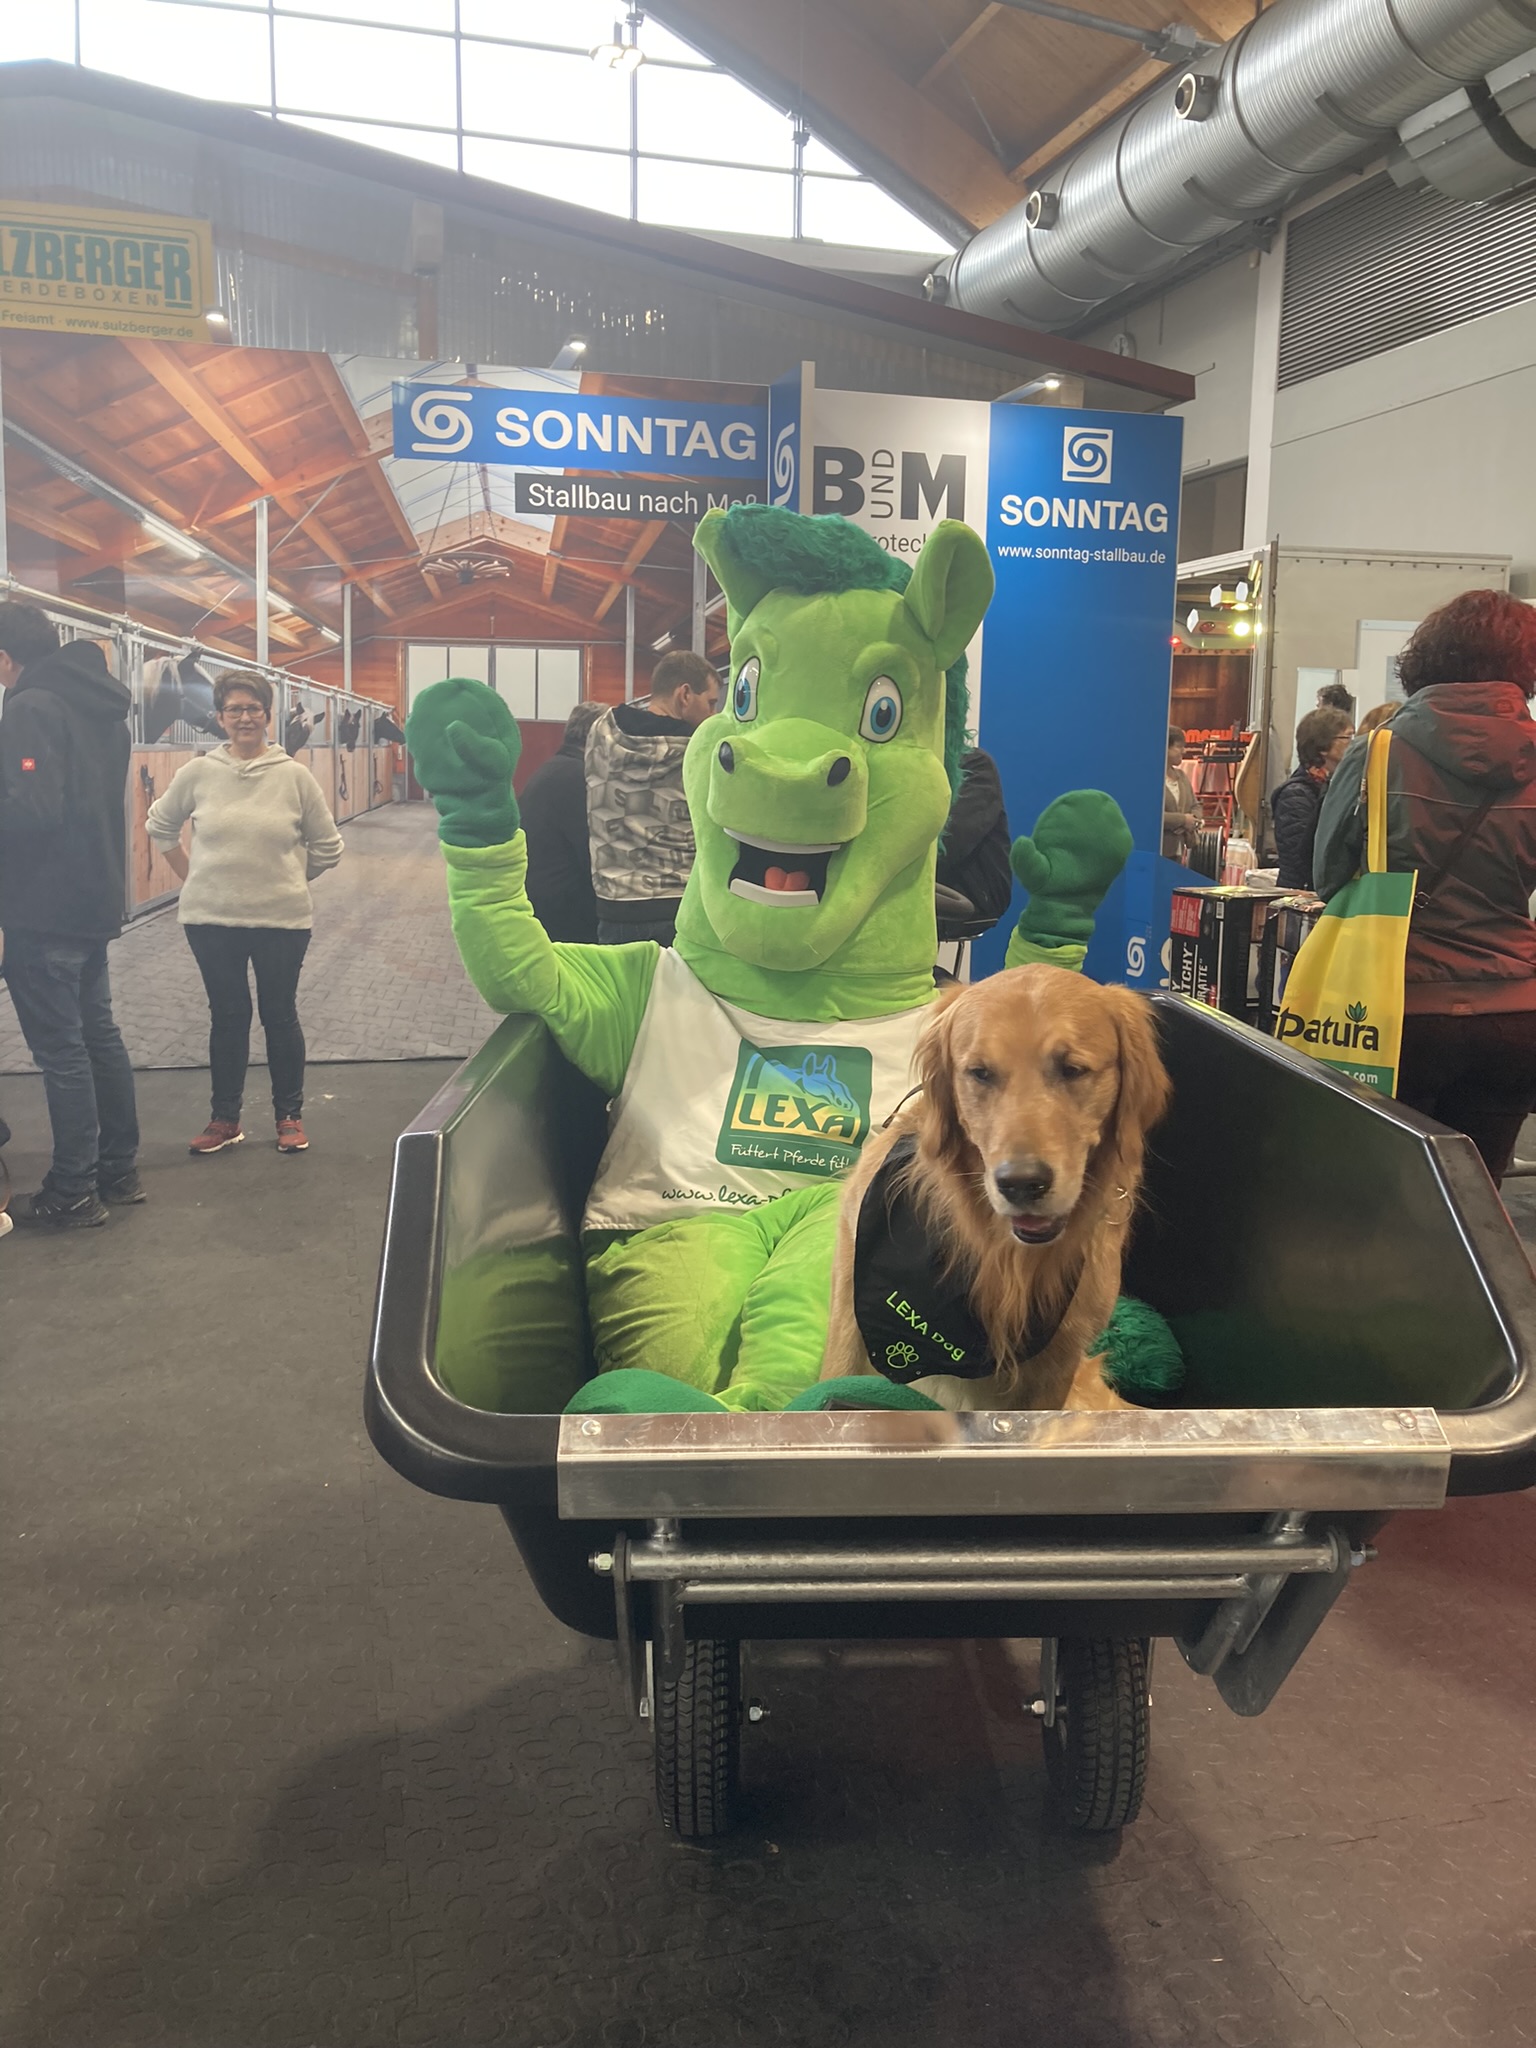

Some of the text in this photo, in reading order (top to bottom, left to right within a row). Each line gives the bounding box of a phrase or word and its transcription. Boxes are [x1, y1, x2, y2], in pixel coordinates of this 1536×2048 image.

[3, 280, 159, 306] ERDEBOXEN
[1, 310, 193, 337] Freiamt www.sulzberger.de
[495, 407, 756, 461] SONNTAG
[528, 483, 630, 511] Stallbau
[639, 491, 697, 515] nach
[812, 445, 967, 522] B UND M
[999, 494, 1168, 533] SONNTAG
[997, 544, 1166, 565] www.sonntag-stallbau.de
[738, 1093, 856, 1138] LEXA
[731, 1143, 779, 1160] Füttert
[783, 1149, 826, 1166] Pferde
[885, 1290, 966, 1362] LEXA Dog
